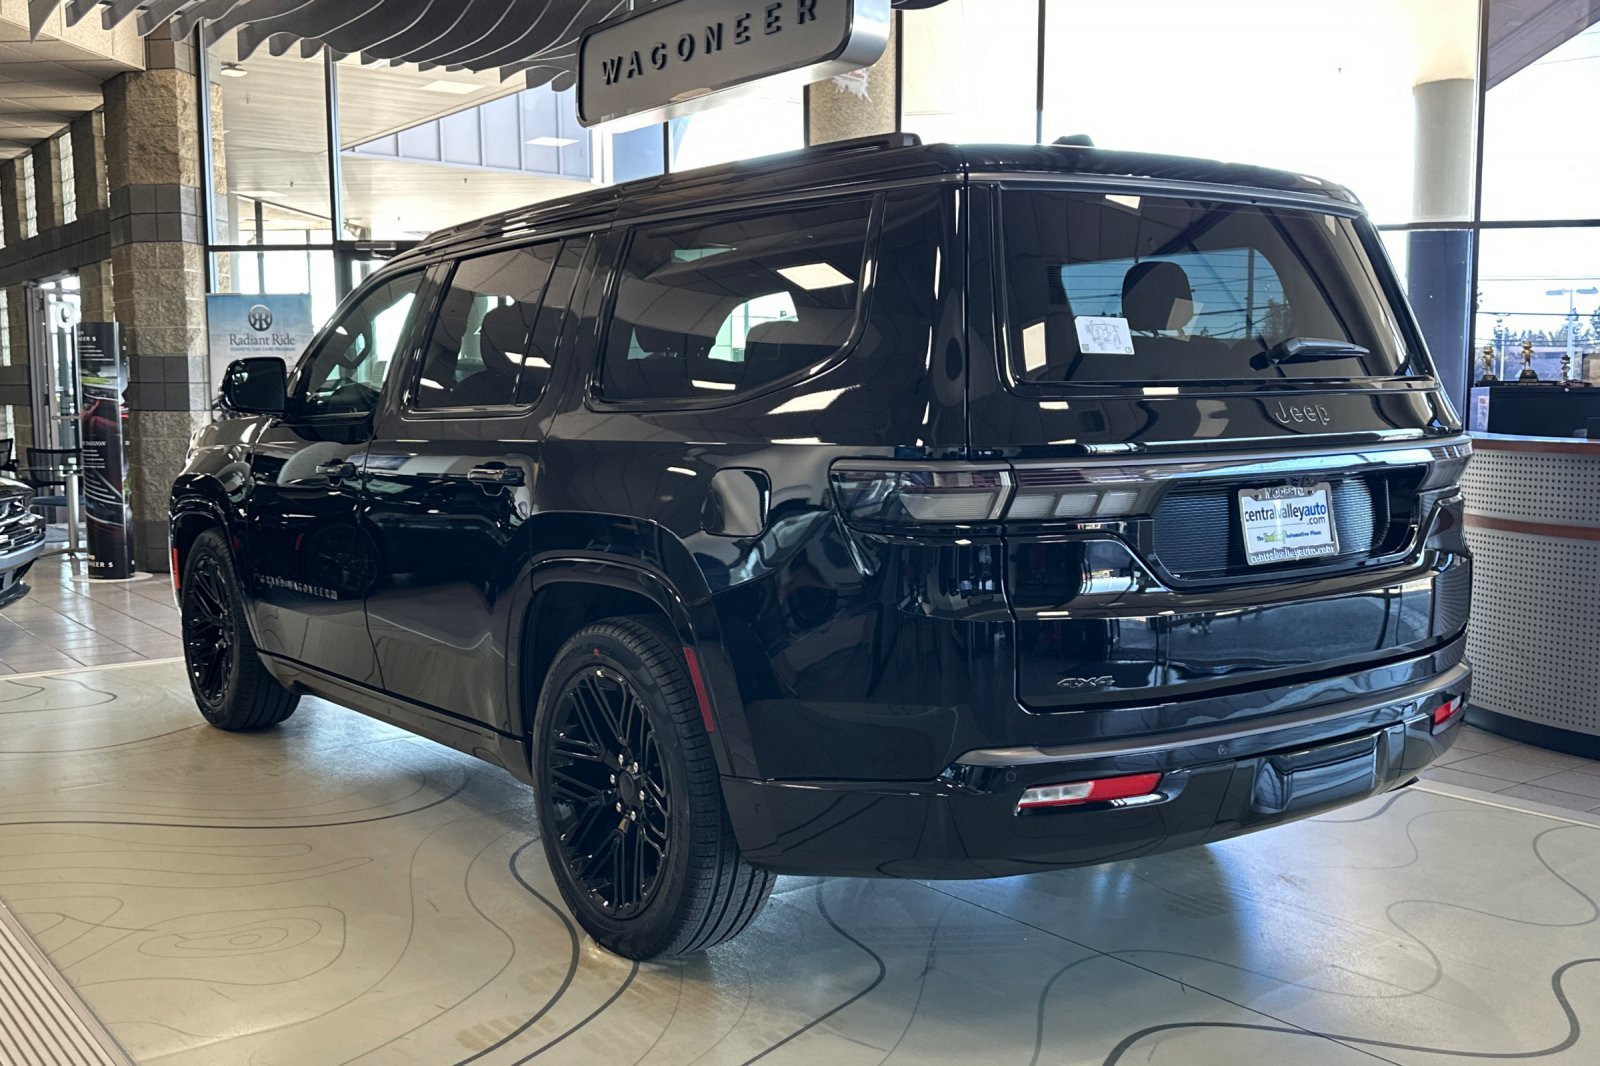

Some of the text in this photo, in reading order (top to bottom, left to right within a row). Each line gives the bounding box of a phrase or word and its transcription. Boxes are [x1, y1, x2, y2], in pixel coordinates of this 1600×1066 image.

[601, 0, 818, 86] WAGONEER
[229, 333, 296, 346] Radiant Ride
[1275, 401, 1330, 425] Jeep
[1244, 502, 1327, 522] centralvalleyauto
[1307, 518, 1326, 526] .com
